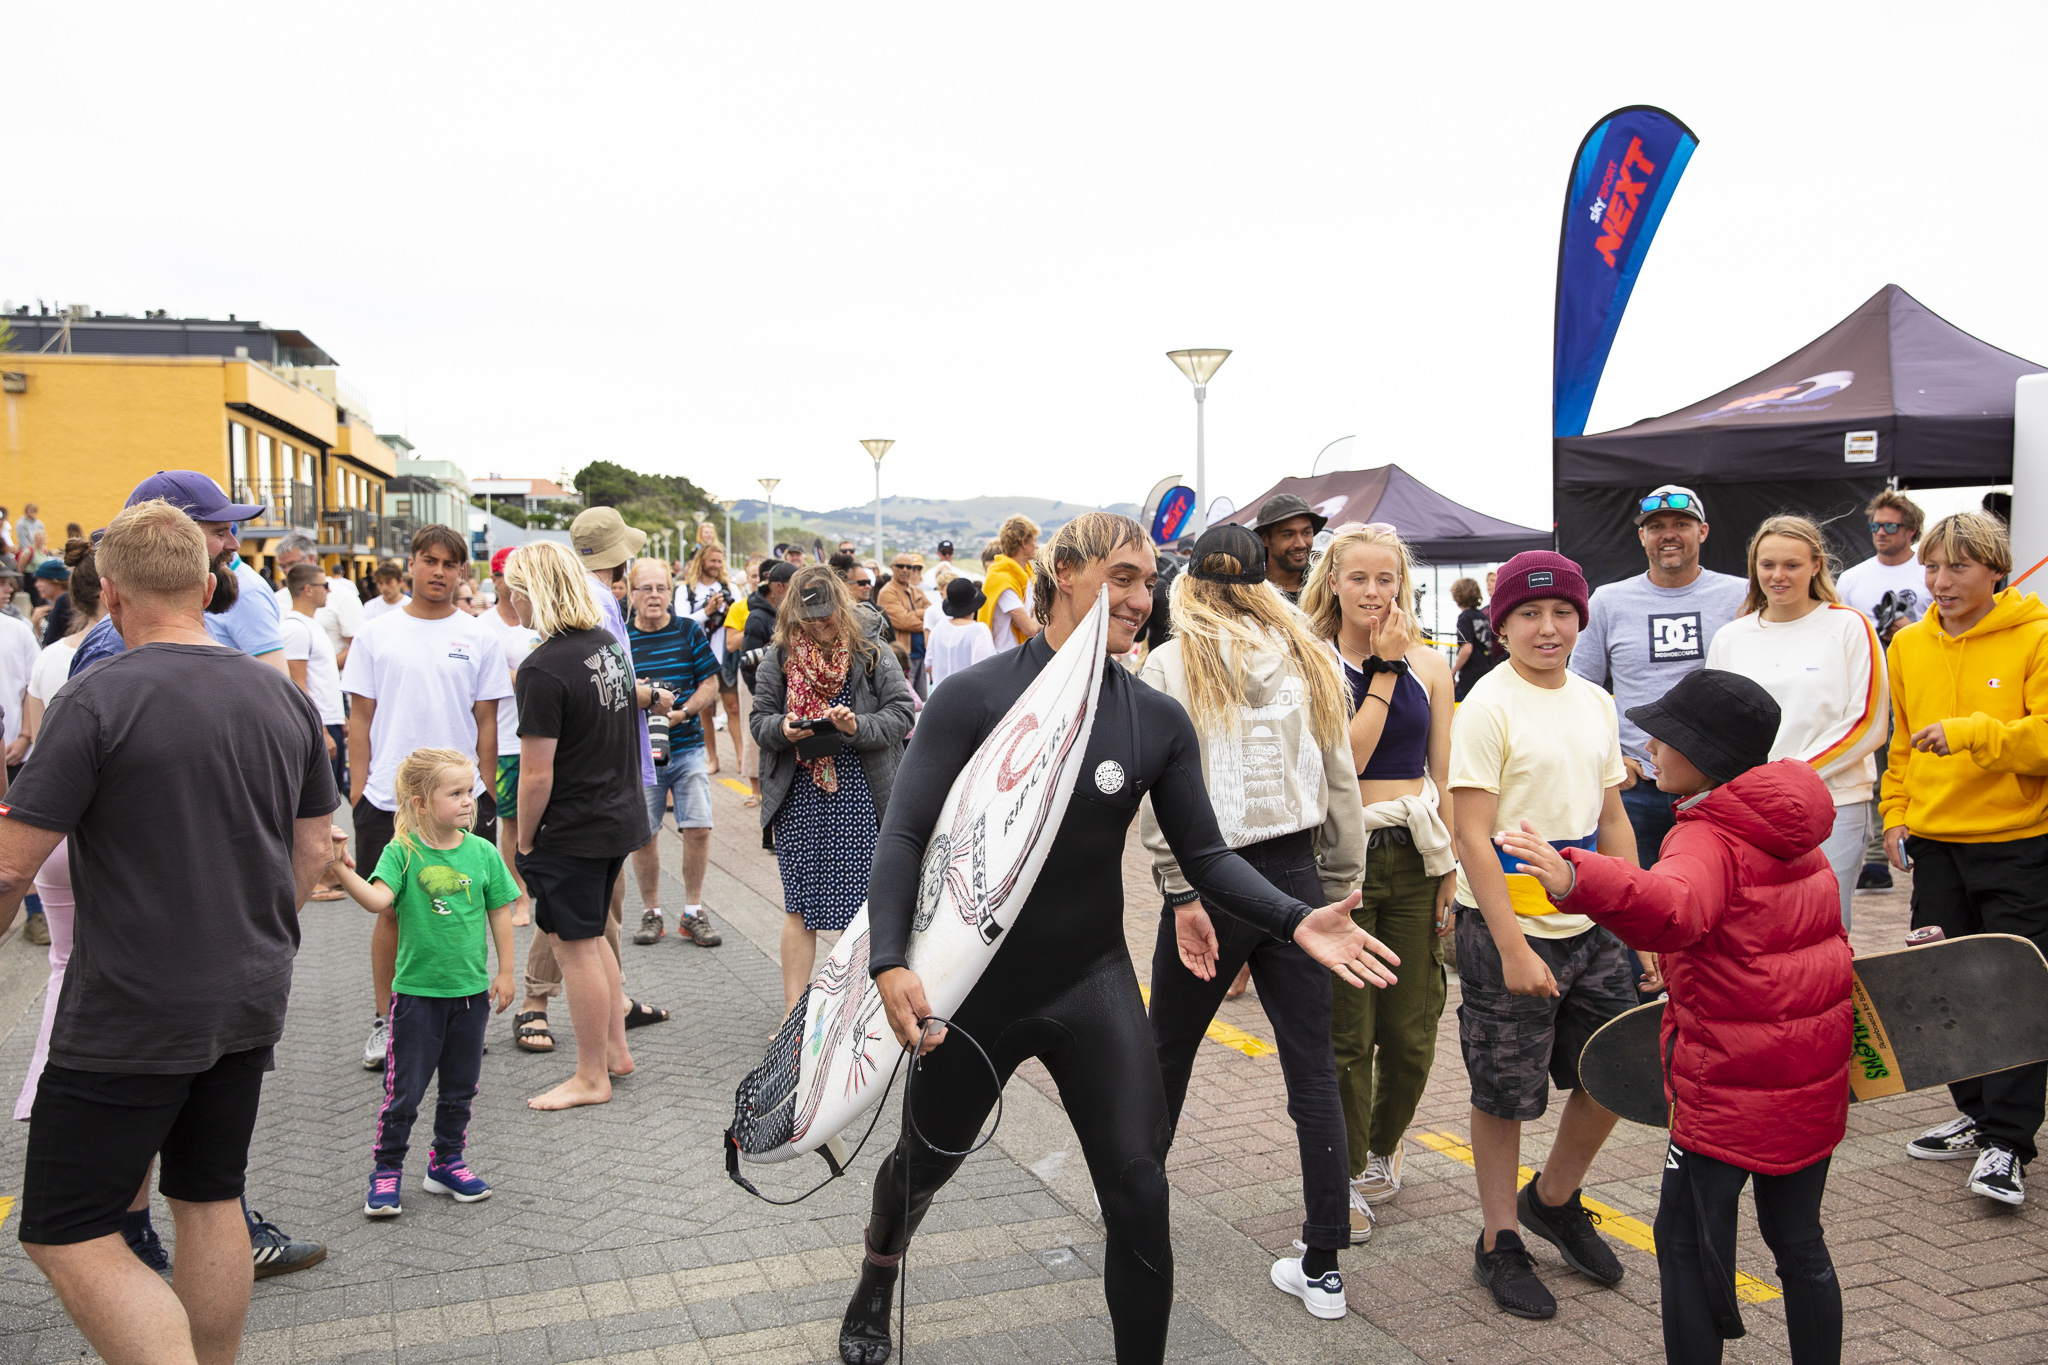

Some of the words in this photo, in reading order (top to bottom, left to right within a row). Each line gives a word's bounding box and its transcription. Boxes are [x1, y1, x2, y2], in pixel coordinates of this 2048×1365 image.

[1598, 158, 1619, 200] SPORT
[1589, 196, 1608, 224] sky
[1594, 135, 1656, 269] NEXT
[1161, 495, 1187, 541] NEXT
[1653, 615, 1698, 653] DC
[1866, 1011, 1887, 1050] Skateboards
